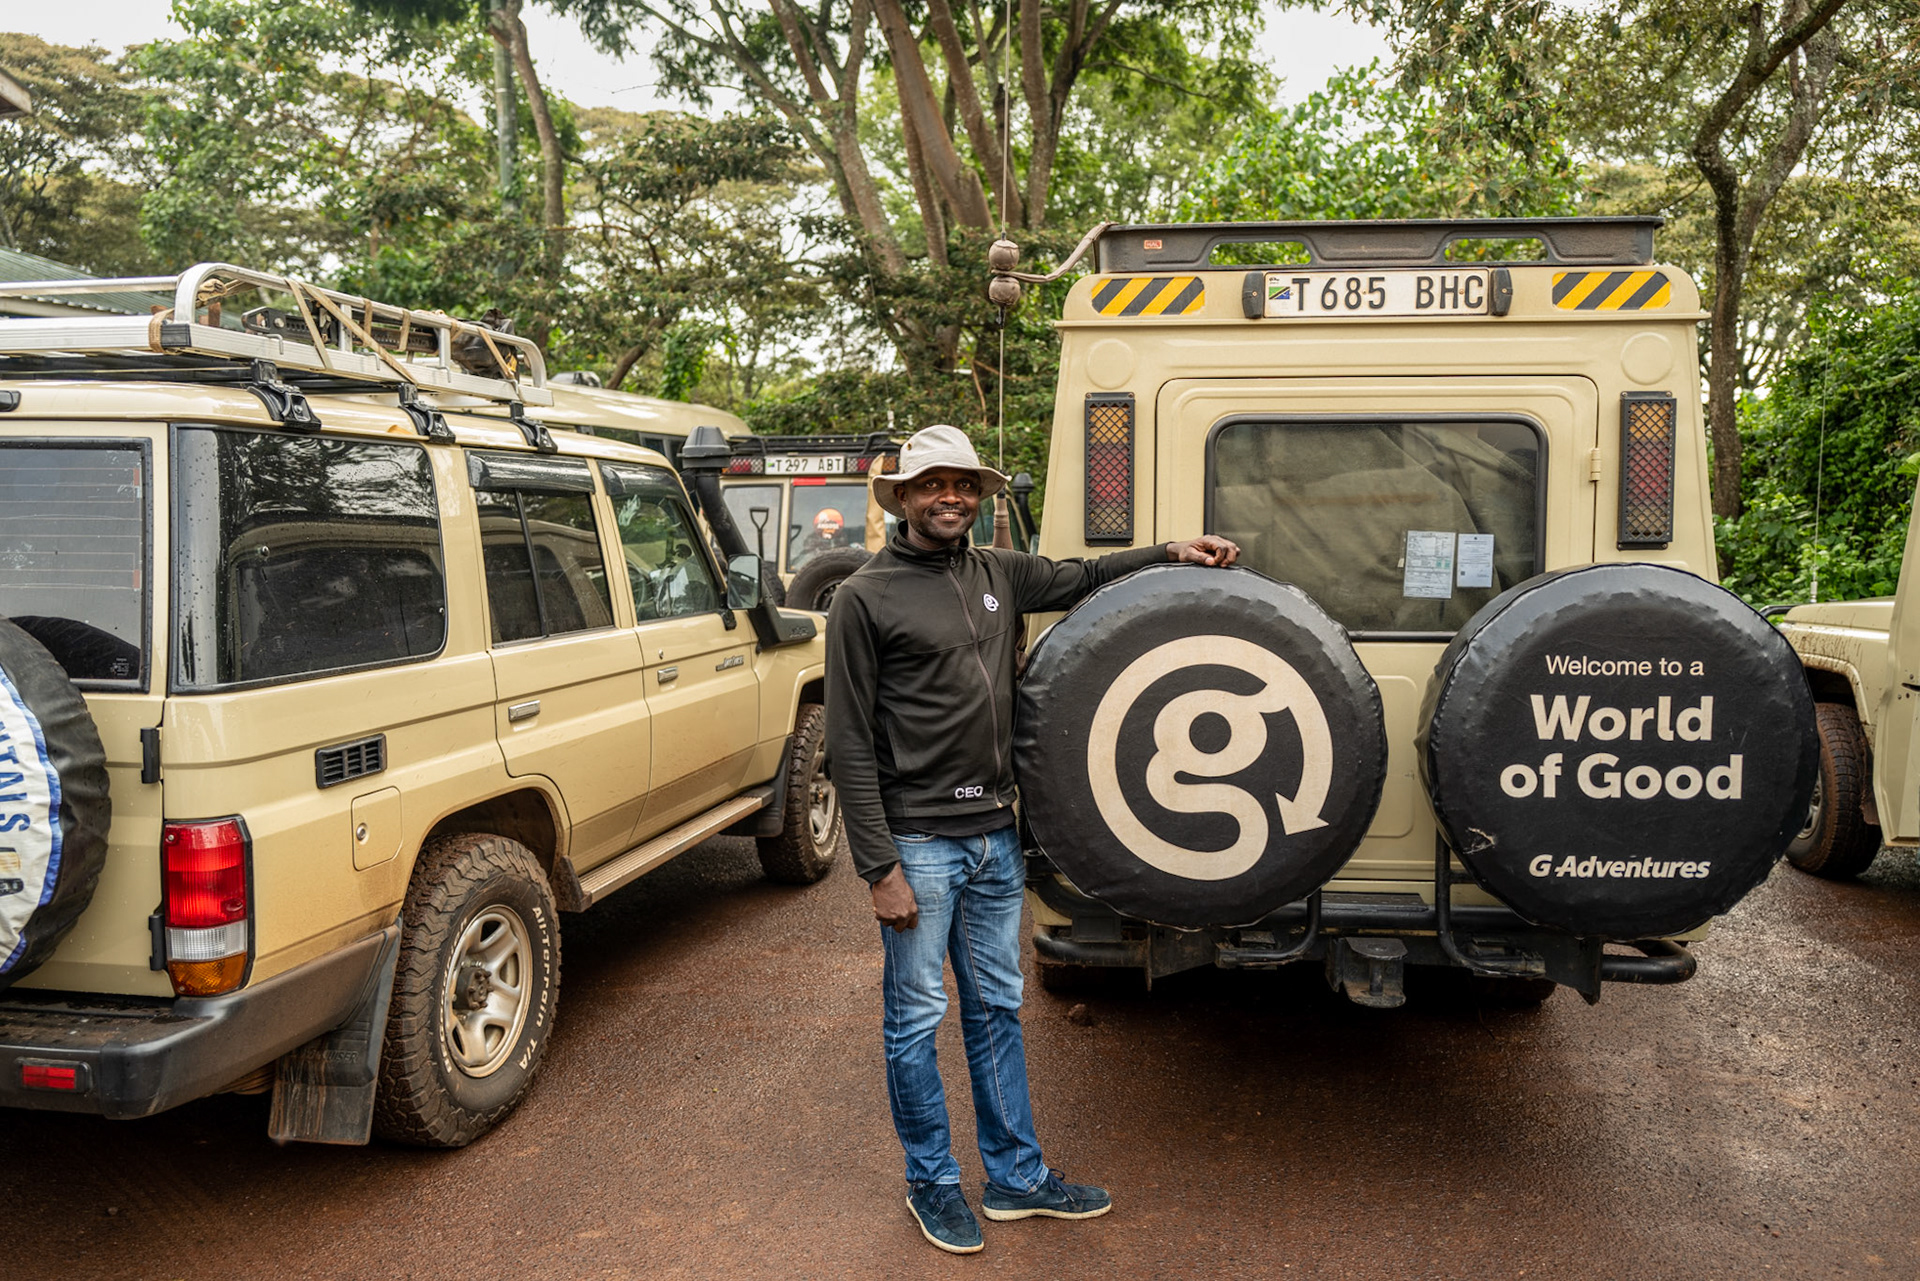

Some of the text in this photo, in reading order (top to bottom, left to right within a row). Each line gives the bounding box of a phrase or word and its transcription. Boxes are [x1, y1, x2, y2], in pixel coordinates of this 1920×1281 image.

[1291, 275, 1483, 311] T 685 BHC
[776, 458, 842, 472] T 297 ABT
[1545, 655, 1705, 676] Welcome to a
[1530, 694, 1714, 742] World
[1500, 753, 1744, 800] of Good
[954, 785, 984, 800] CEO
[1554, 855, 1711, 879] Adventures
[518, 907, 550, 1070] All-Terrain T/A
